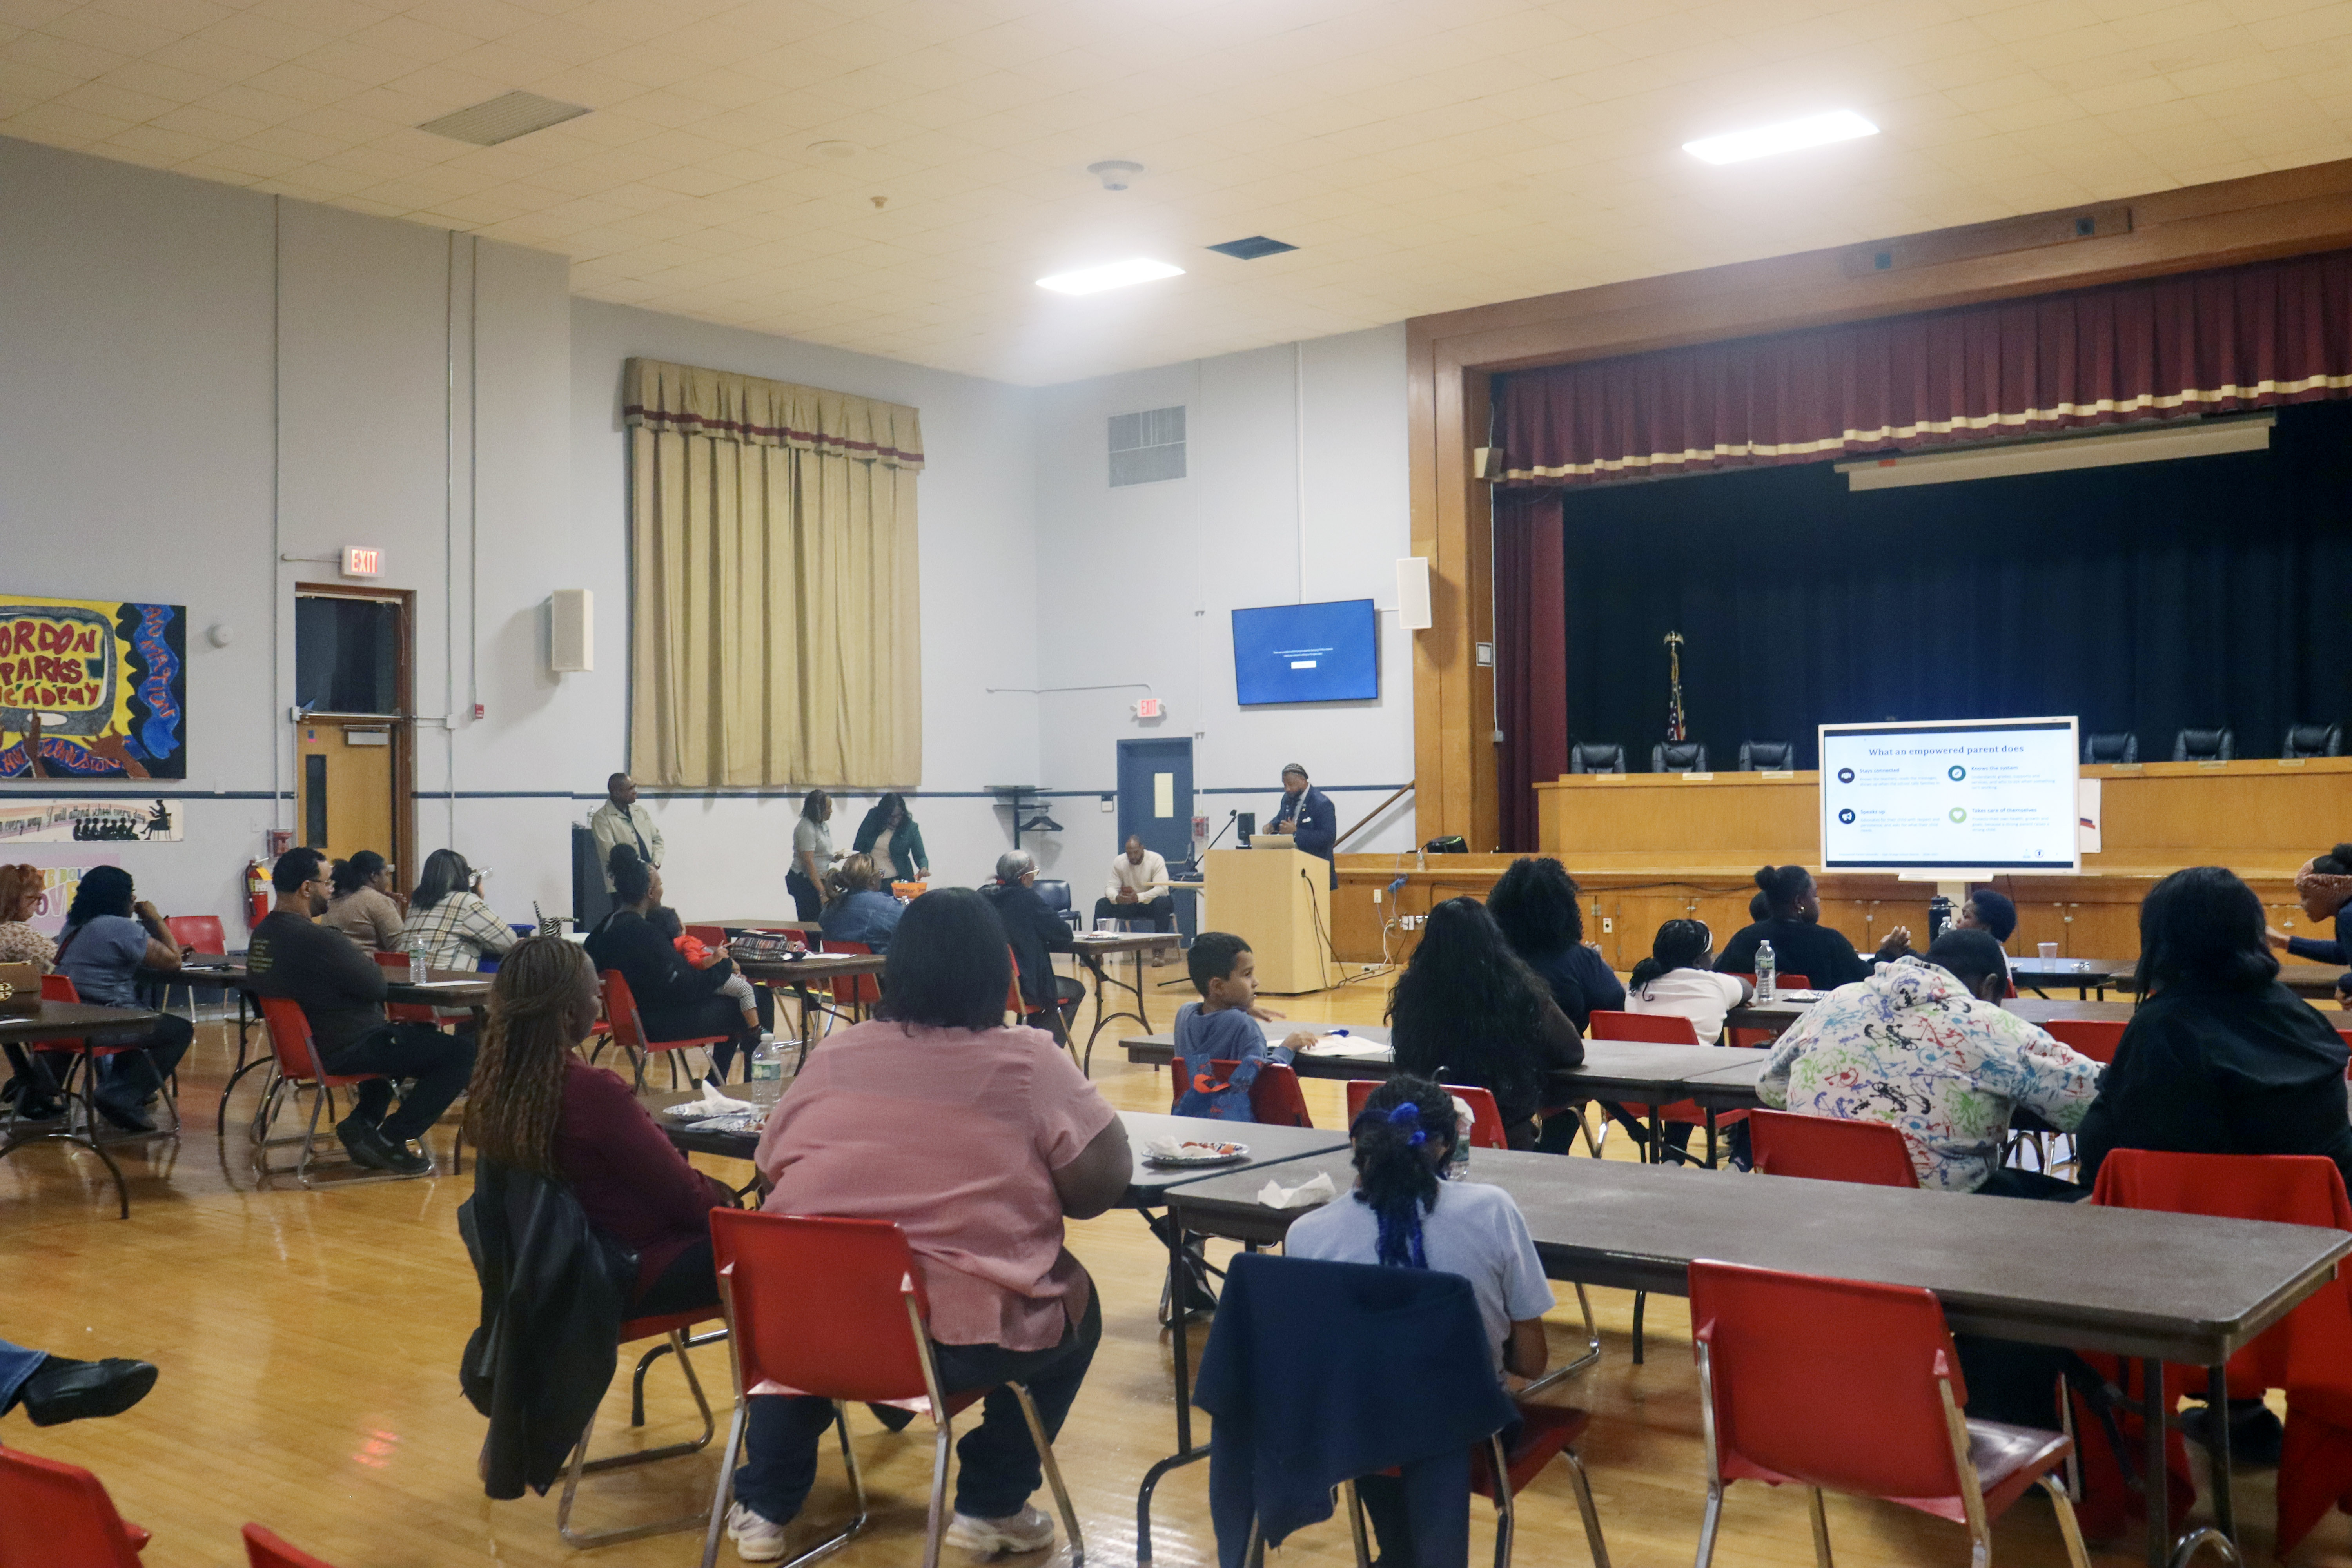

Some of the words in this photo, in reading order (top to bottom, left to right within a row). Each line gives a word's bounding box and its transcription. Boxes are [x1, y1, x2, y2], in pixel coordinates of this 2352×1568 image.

[351, 549, 379, 574] EXIT
[0, 621, 97, 657] ORDON
[0, 655, 83, 686] PARKS
[0, 682, 99, 706] CADEMY
[1140, 699, 1157, 716] EXIT
[1909, 746, 1964, 756] empowered
[1967, 746, 1999, 755] parent
[92, 803, 112, 817] school
[113, 808, 131, 822] every
[133, 809, 145, 824] day
